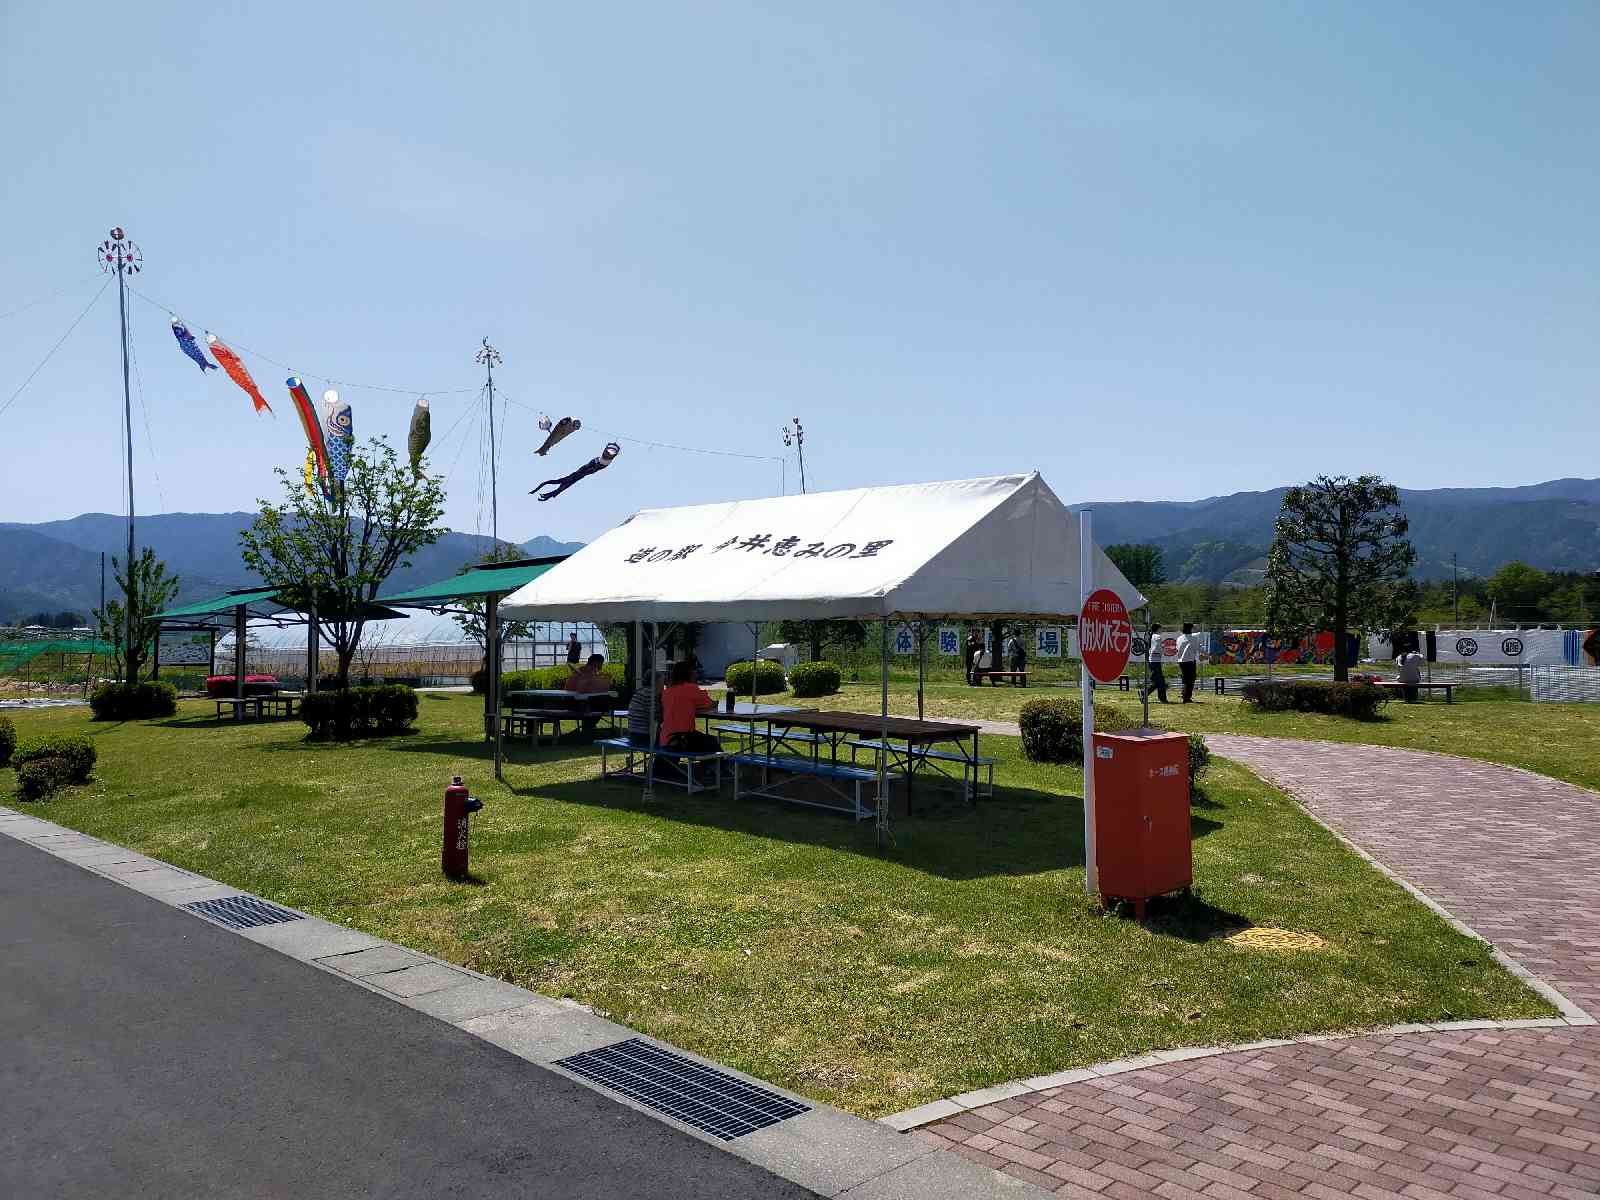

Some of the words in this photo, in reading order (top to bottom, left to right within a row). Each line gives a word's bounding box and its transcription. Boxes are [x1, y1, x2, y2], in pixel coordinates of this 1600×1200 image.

[711, 534, 894, 560] 井恵みの里
[1038, 631, 1059, 654] 場
